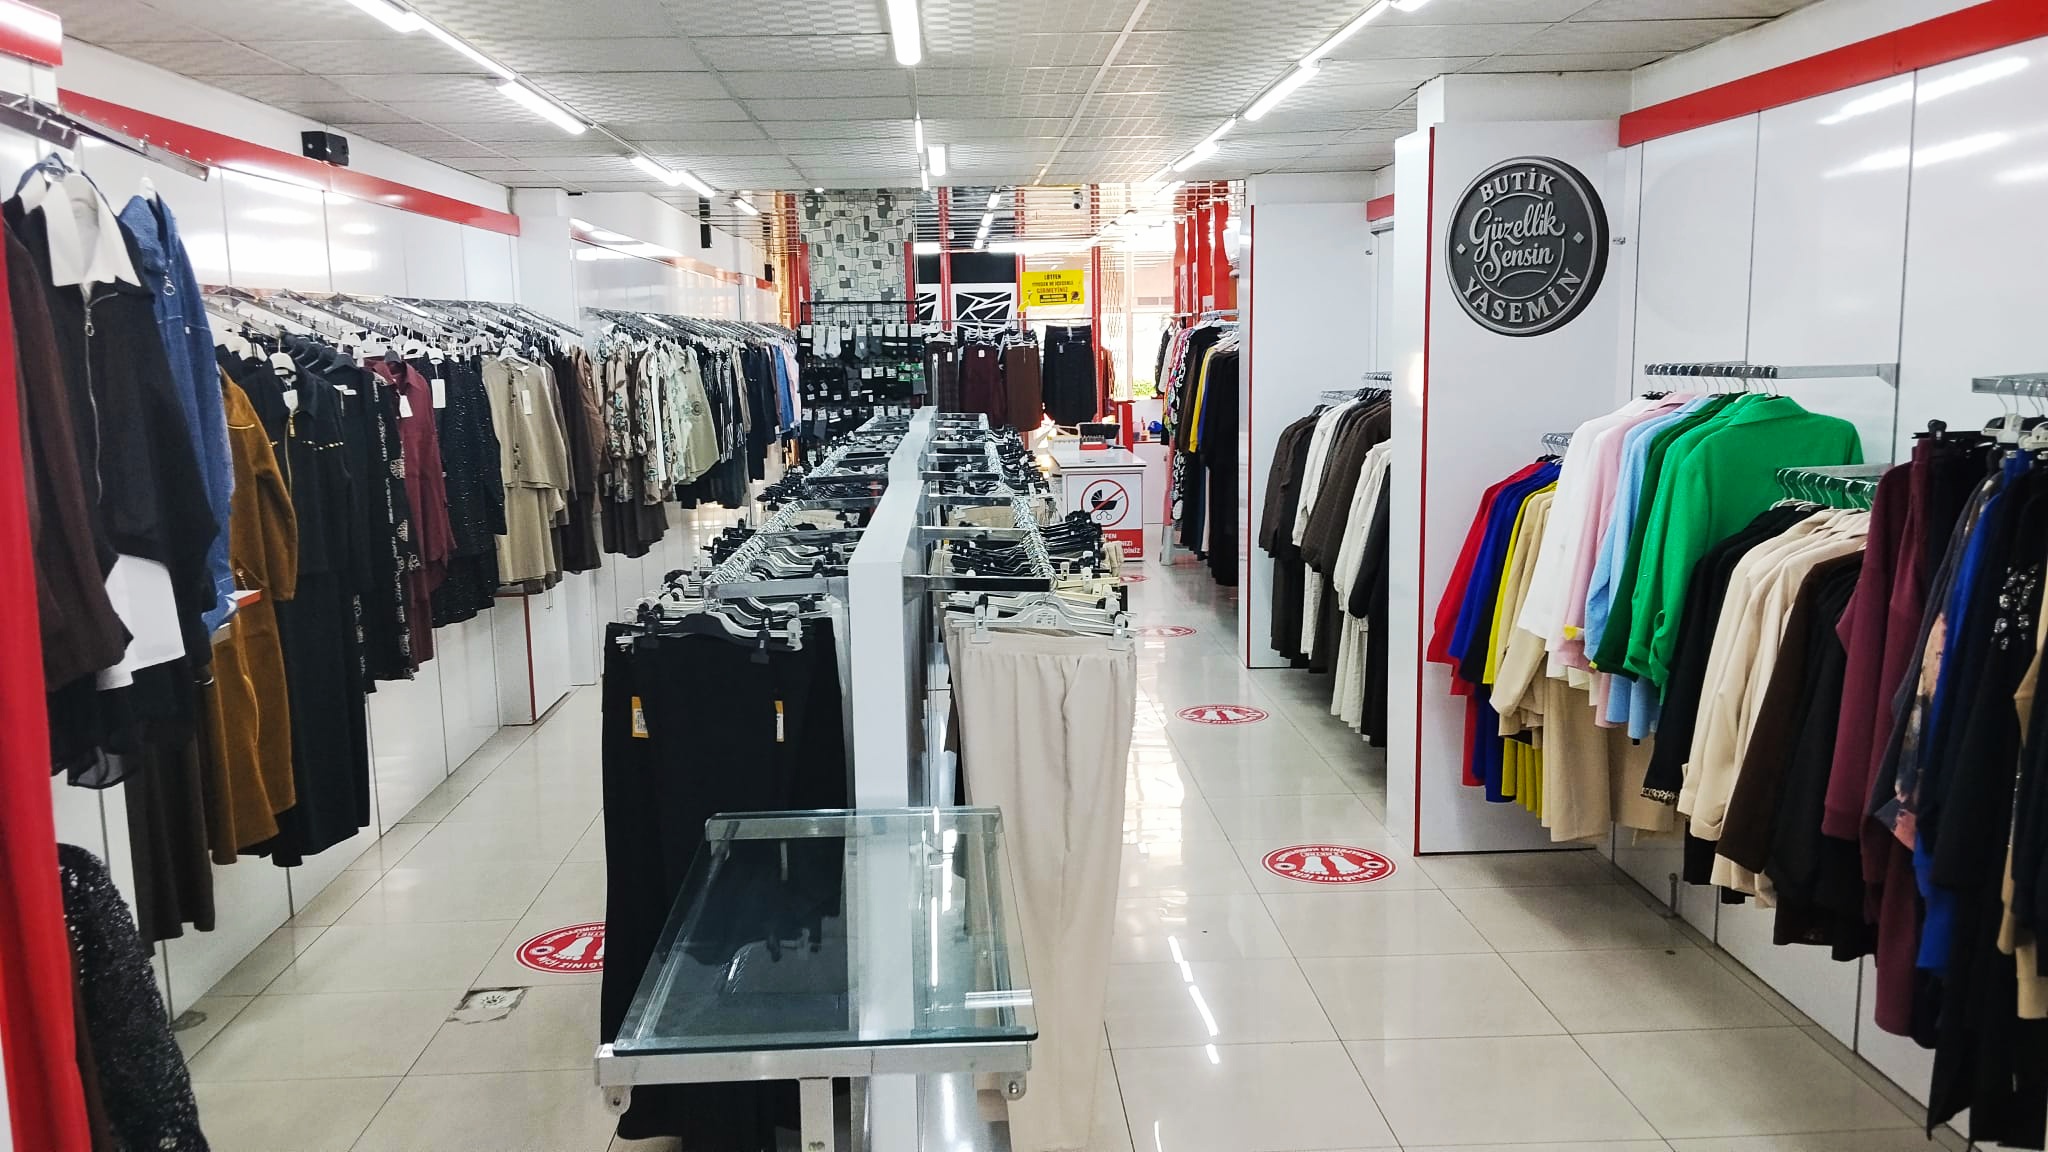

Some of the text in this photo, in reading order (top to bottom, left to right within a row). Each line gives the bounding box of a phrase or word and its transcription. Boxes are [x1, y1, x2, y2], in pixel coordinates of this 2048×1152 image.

[1479, 168, 1556, 203] BUTİK
[1469, 201, 1566, 263] Güzellik
[1481, 241, 1554, 283] Sensin
[1463, 267, 1583, 323] YASEMİN
